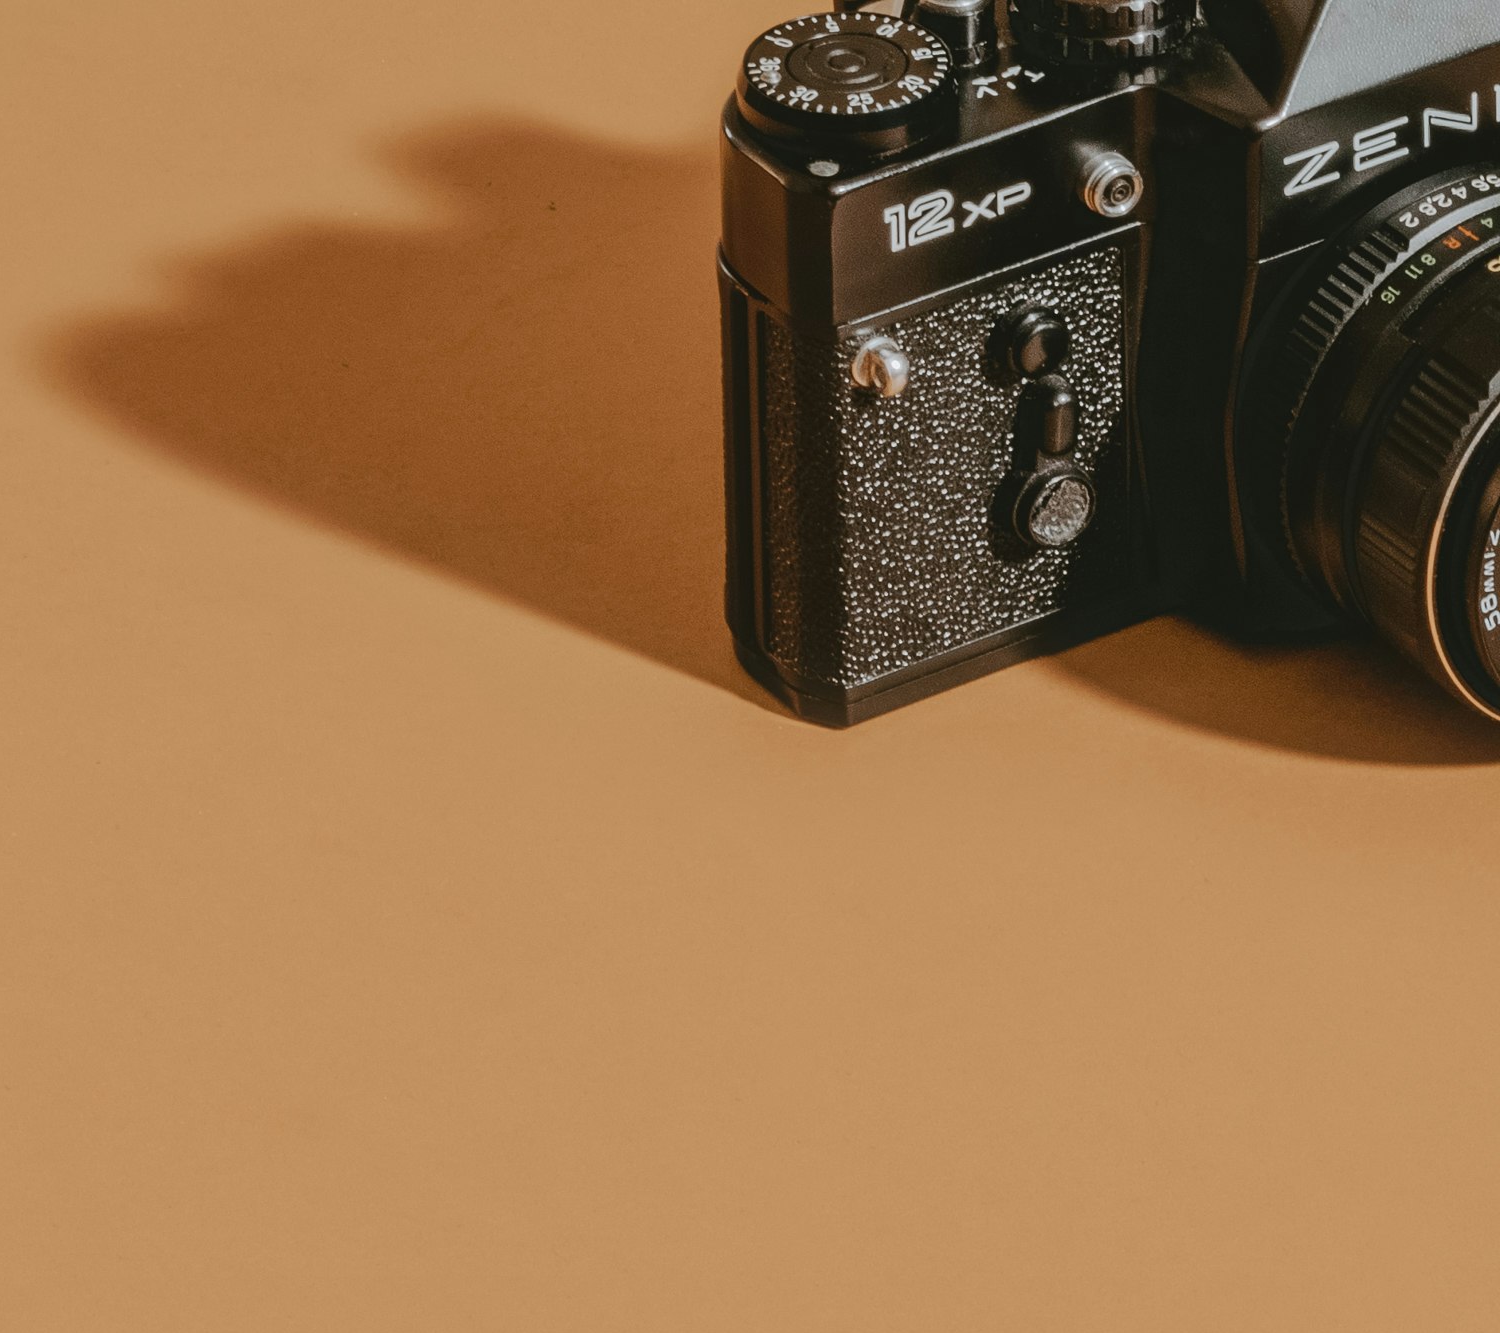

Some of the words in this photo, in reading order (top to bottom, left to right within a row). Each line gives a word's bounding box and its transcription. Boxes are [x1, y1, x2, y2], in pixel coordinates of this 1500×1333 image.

[875, 25, 895, 38] 10
[897, 76, 923, 93] 20
[789, 85, 819, 102] 30
[847, 92, 874, 107] 25
[1450, 186, 1467, 200] 4
[1418, 193, 1453, 217] 2,8
[883, 187, 956, 254] 12
[961, 182, 1032, 229] XP
[1398, 212, 1420, 229] 2
